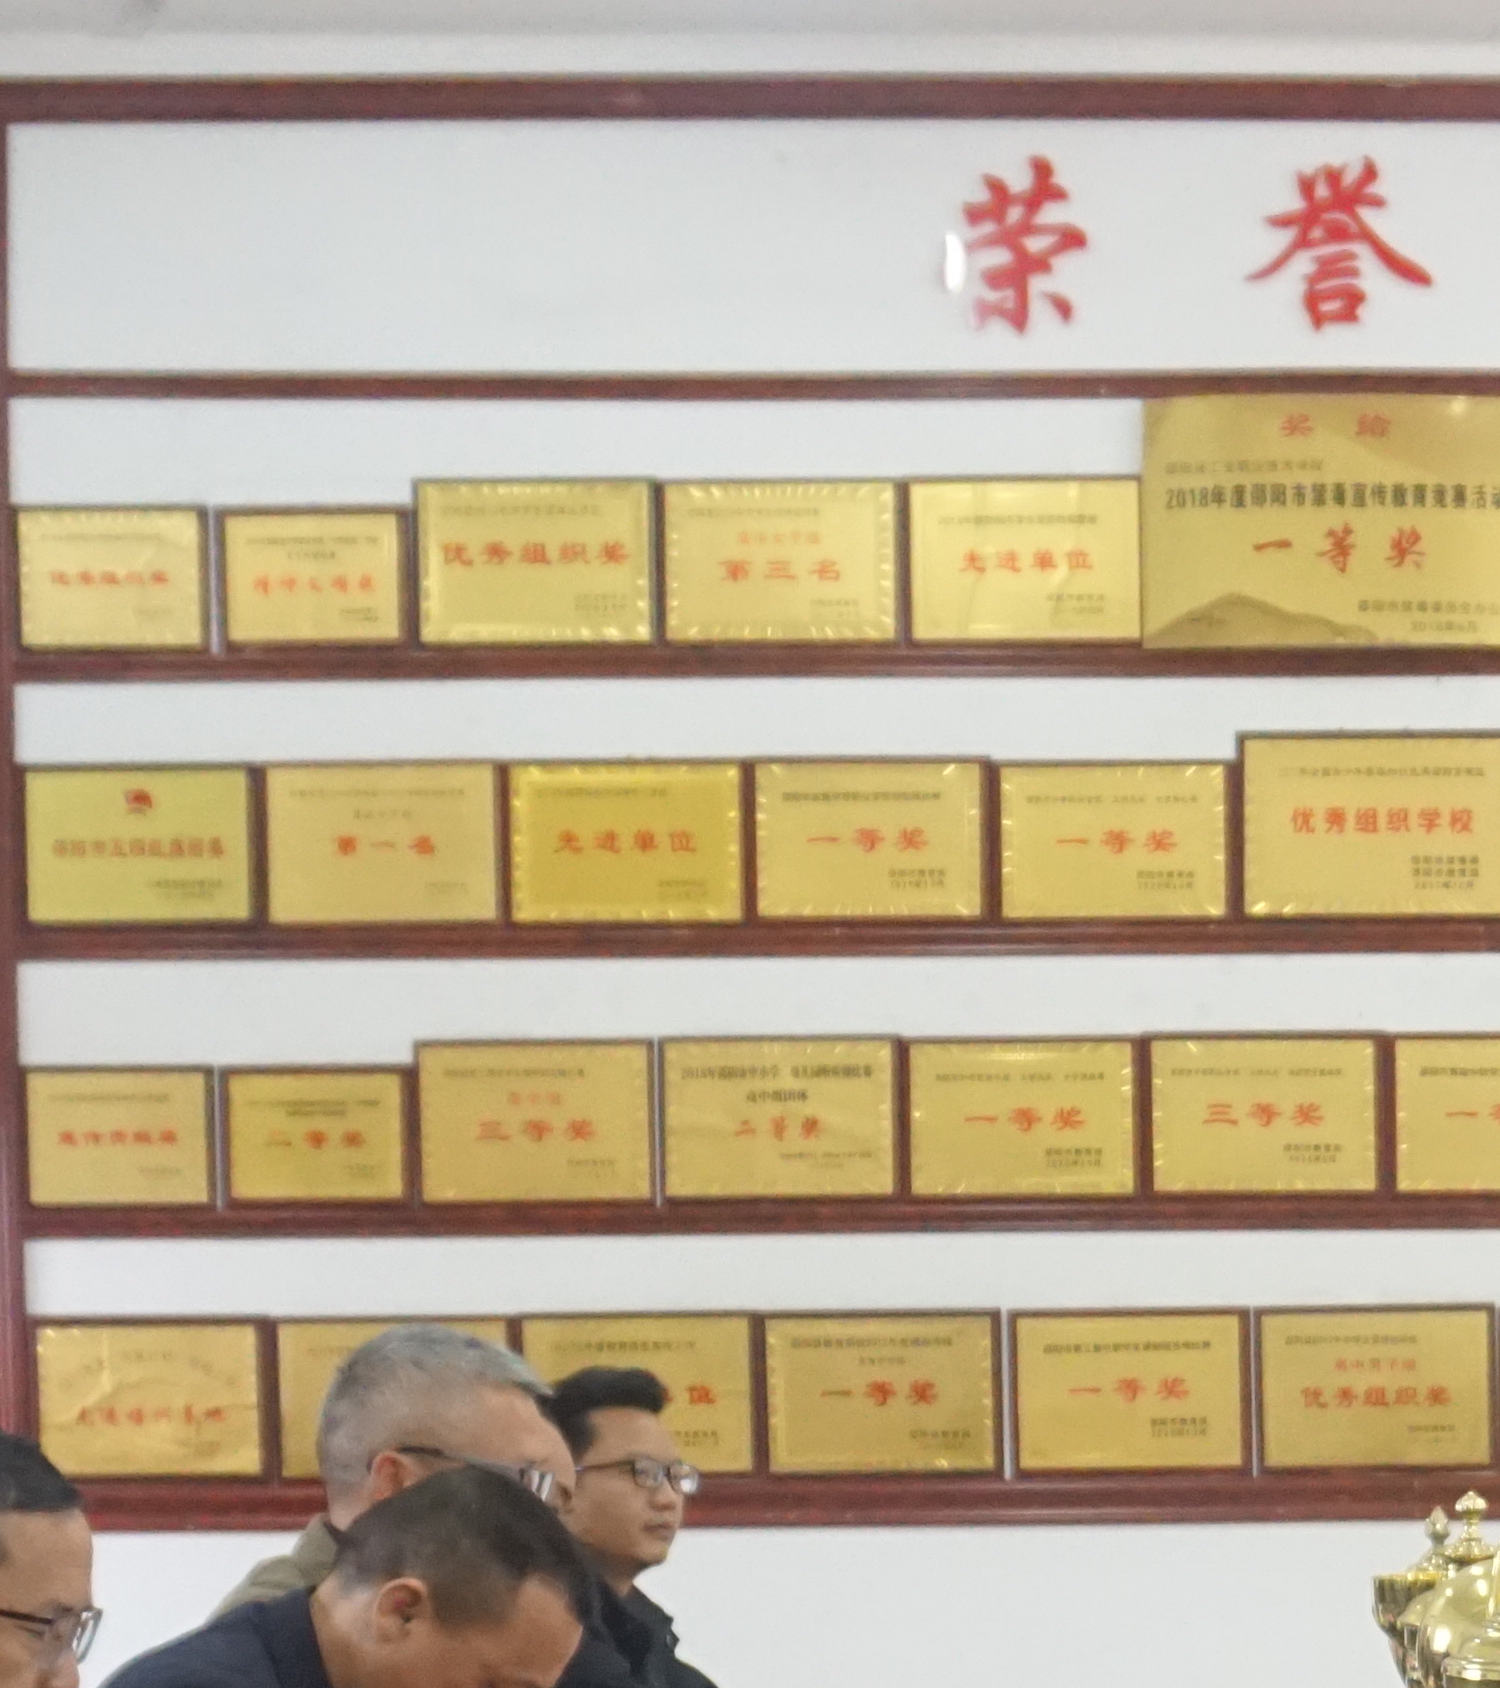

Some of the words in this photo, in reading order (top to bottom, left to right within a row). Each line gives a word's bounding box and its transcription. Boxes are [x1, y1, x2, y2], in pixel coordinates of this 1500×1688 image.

[442, 541, 631, 567] 优秀组织奖
[1252, 522, 1426, 574] 一等奖
[718, 558, 843, 583] 第三名
[959, 548, 1095, 574] 先进单位
[1290, 807, 1475, 835] 优秀组织学校
[555, 829, 697, 854] 先进单位
[807, 827, 929, 851] 一等奖
[1056, 829, 1179, 855] 一等奖
[964, 1107, 1086, 1131] 一等奖
[1203, 1103, 1325, 1128] 三等奖
[820, 1380, 938, 1406] 一等奖
[1068, 1377, 1190, 1402] 一等奖
[1300, 1385, 1452, 1408] 优秀组织奖
